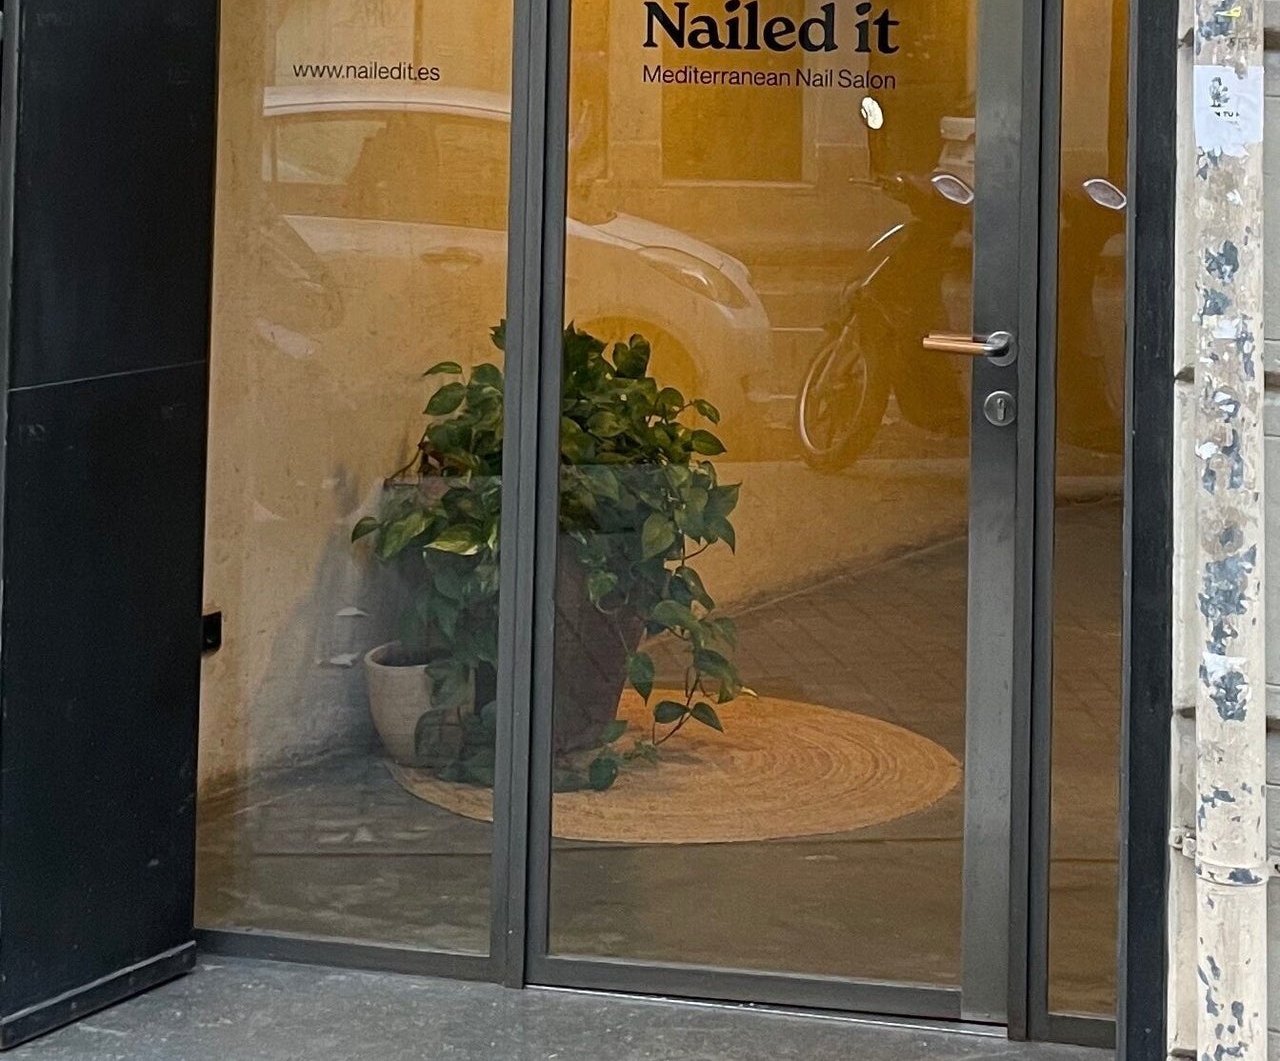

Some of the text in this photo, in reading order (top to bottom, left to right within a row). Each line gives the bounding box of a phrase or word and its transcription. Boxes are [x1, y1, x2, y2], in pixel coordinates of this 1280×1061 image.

[643, 0, 900, 54] Nailed it
[293, 61, 441, 81] www.nailedit.es
[643, 65, 896, 89] Mediterranean Nail Salon
